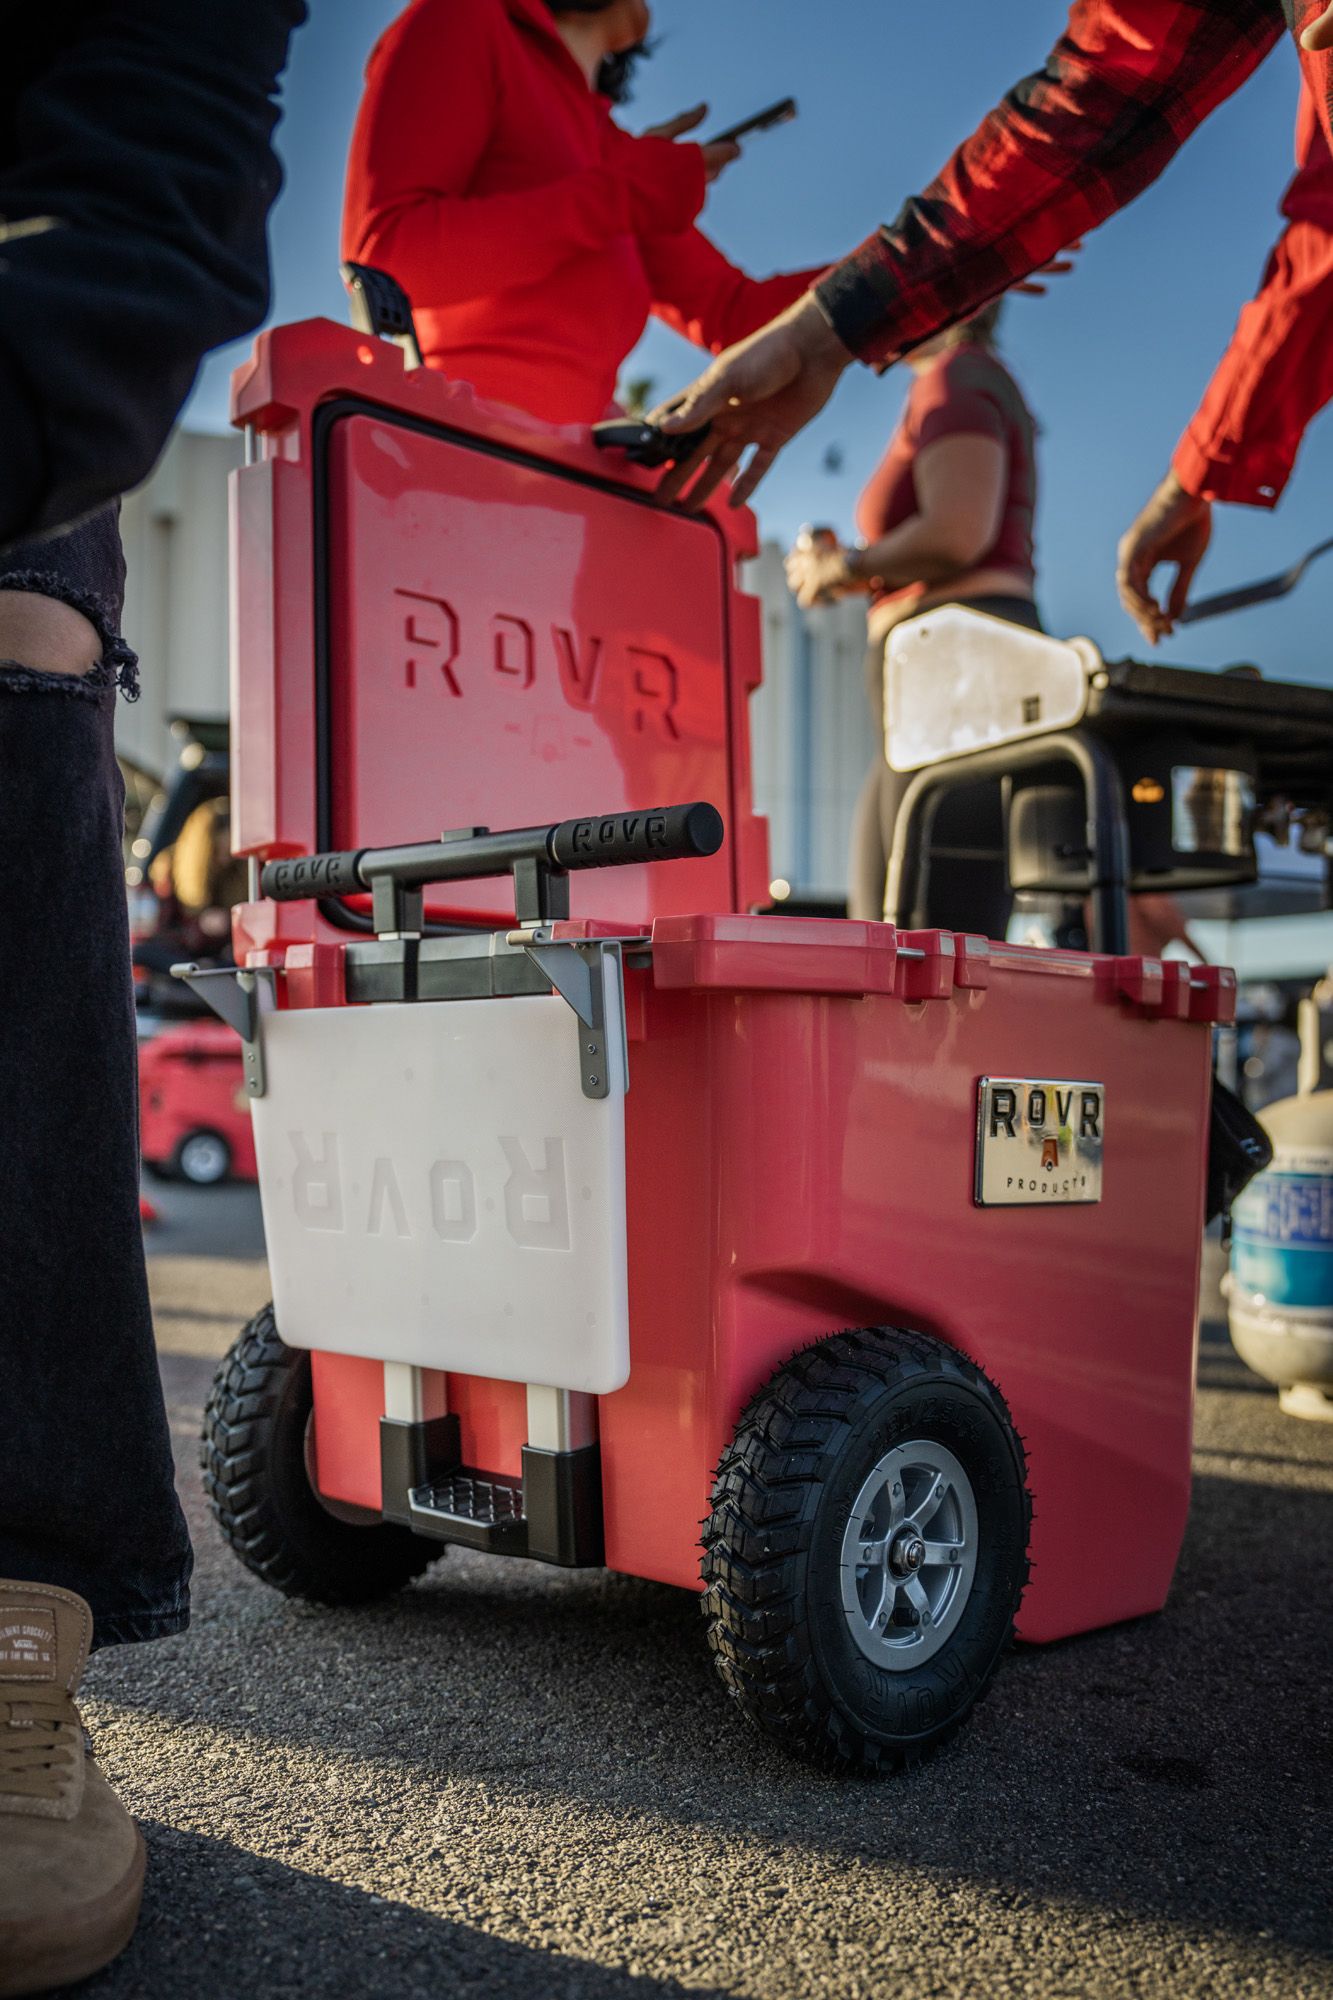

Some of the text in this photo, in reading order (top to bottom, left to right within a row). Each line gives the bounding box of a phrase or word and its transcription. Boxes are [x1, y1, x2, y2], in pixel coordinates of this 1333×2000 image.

[393, 586, 681, 740] ROVR
[571, 815, 671, 853] ROVR
[274, 855, 342, 891] ROVR
[989, 1087, 1101, 1138] ROVR
[286, 1129, 573, 1253] ROVR
[1006, 1175, 1087, 1194] PRODUCTS
